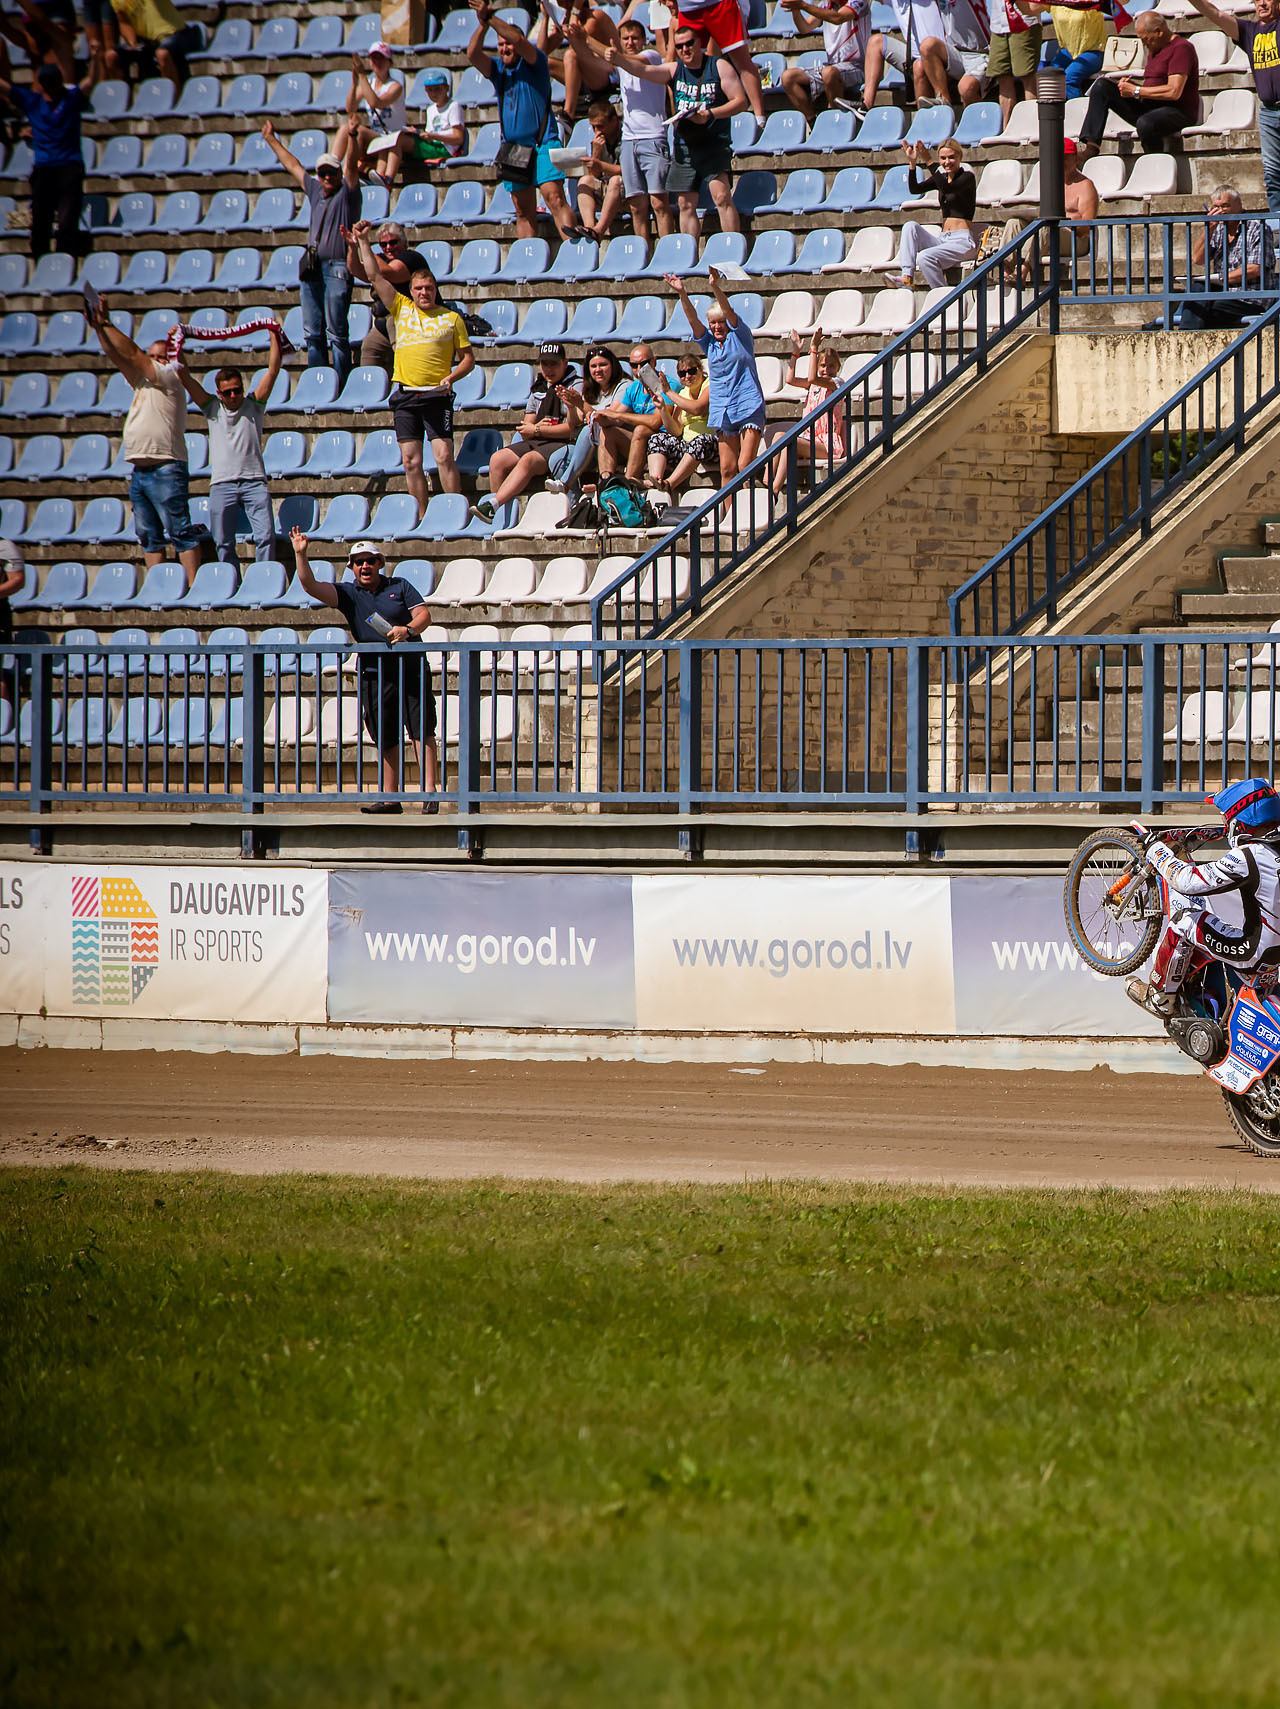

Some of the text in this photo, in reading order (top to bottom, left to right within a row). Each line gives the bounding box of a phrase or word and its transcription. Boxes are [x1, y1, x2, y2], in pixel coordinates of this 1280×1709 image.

[1252, 51, 1264, 63] THE
[834, 113, 840, 123] 9
[931, 110, 938, 120] 7
[980, 110, 987, 119] 6
[783, 117, 794, 128] 10
[854, 172, 860, 182] 7
[463, 189, 470, 199] 15
[676, 239, 682, 249] 9
[774, 235, 781, 246] 7
[478, 247, 488, 257] 13
[525, 246, 533, 257] 12
[577, 245, 584, 255] 11
[624, 244, 633, 254] 10
[496, 304, 506, 315] 11
[545, 303, 554, 313] 10
[596, 302, 602, 313] 9
[540, 344, 559, 354] ICON
[363, 372, 372, 382] 12
[514, 366, 520, 377] 9
[316, 372, 324, 384] 13
[332, 436, 340, 446] 11
[382, 434, 393, 446] 10
[199, 499, 209, 512] 12
[165, 567, 174, 577] 11
[1225, 788, 1266, 821] SCOTT
[170, 881, 305, 917] DAUGAVPILS
[170, 928, 264, 963] IR SPORTS
[365, 926, 598, 974] www.gorod.lv
[673, 930, 912, 978] www.gorod.lv
